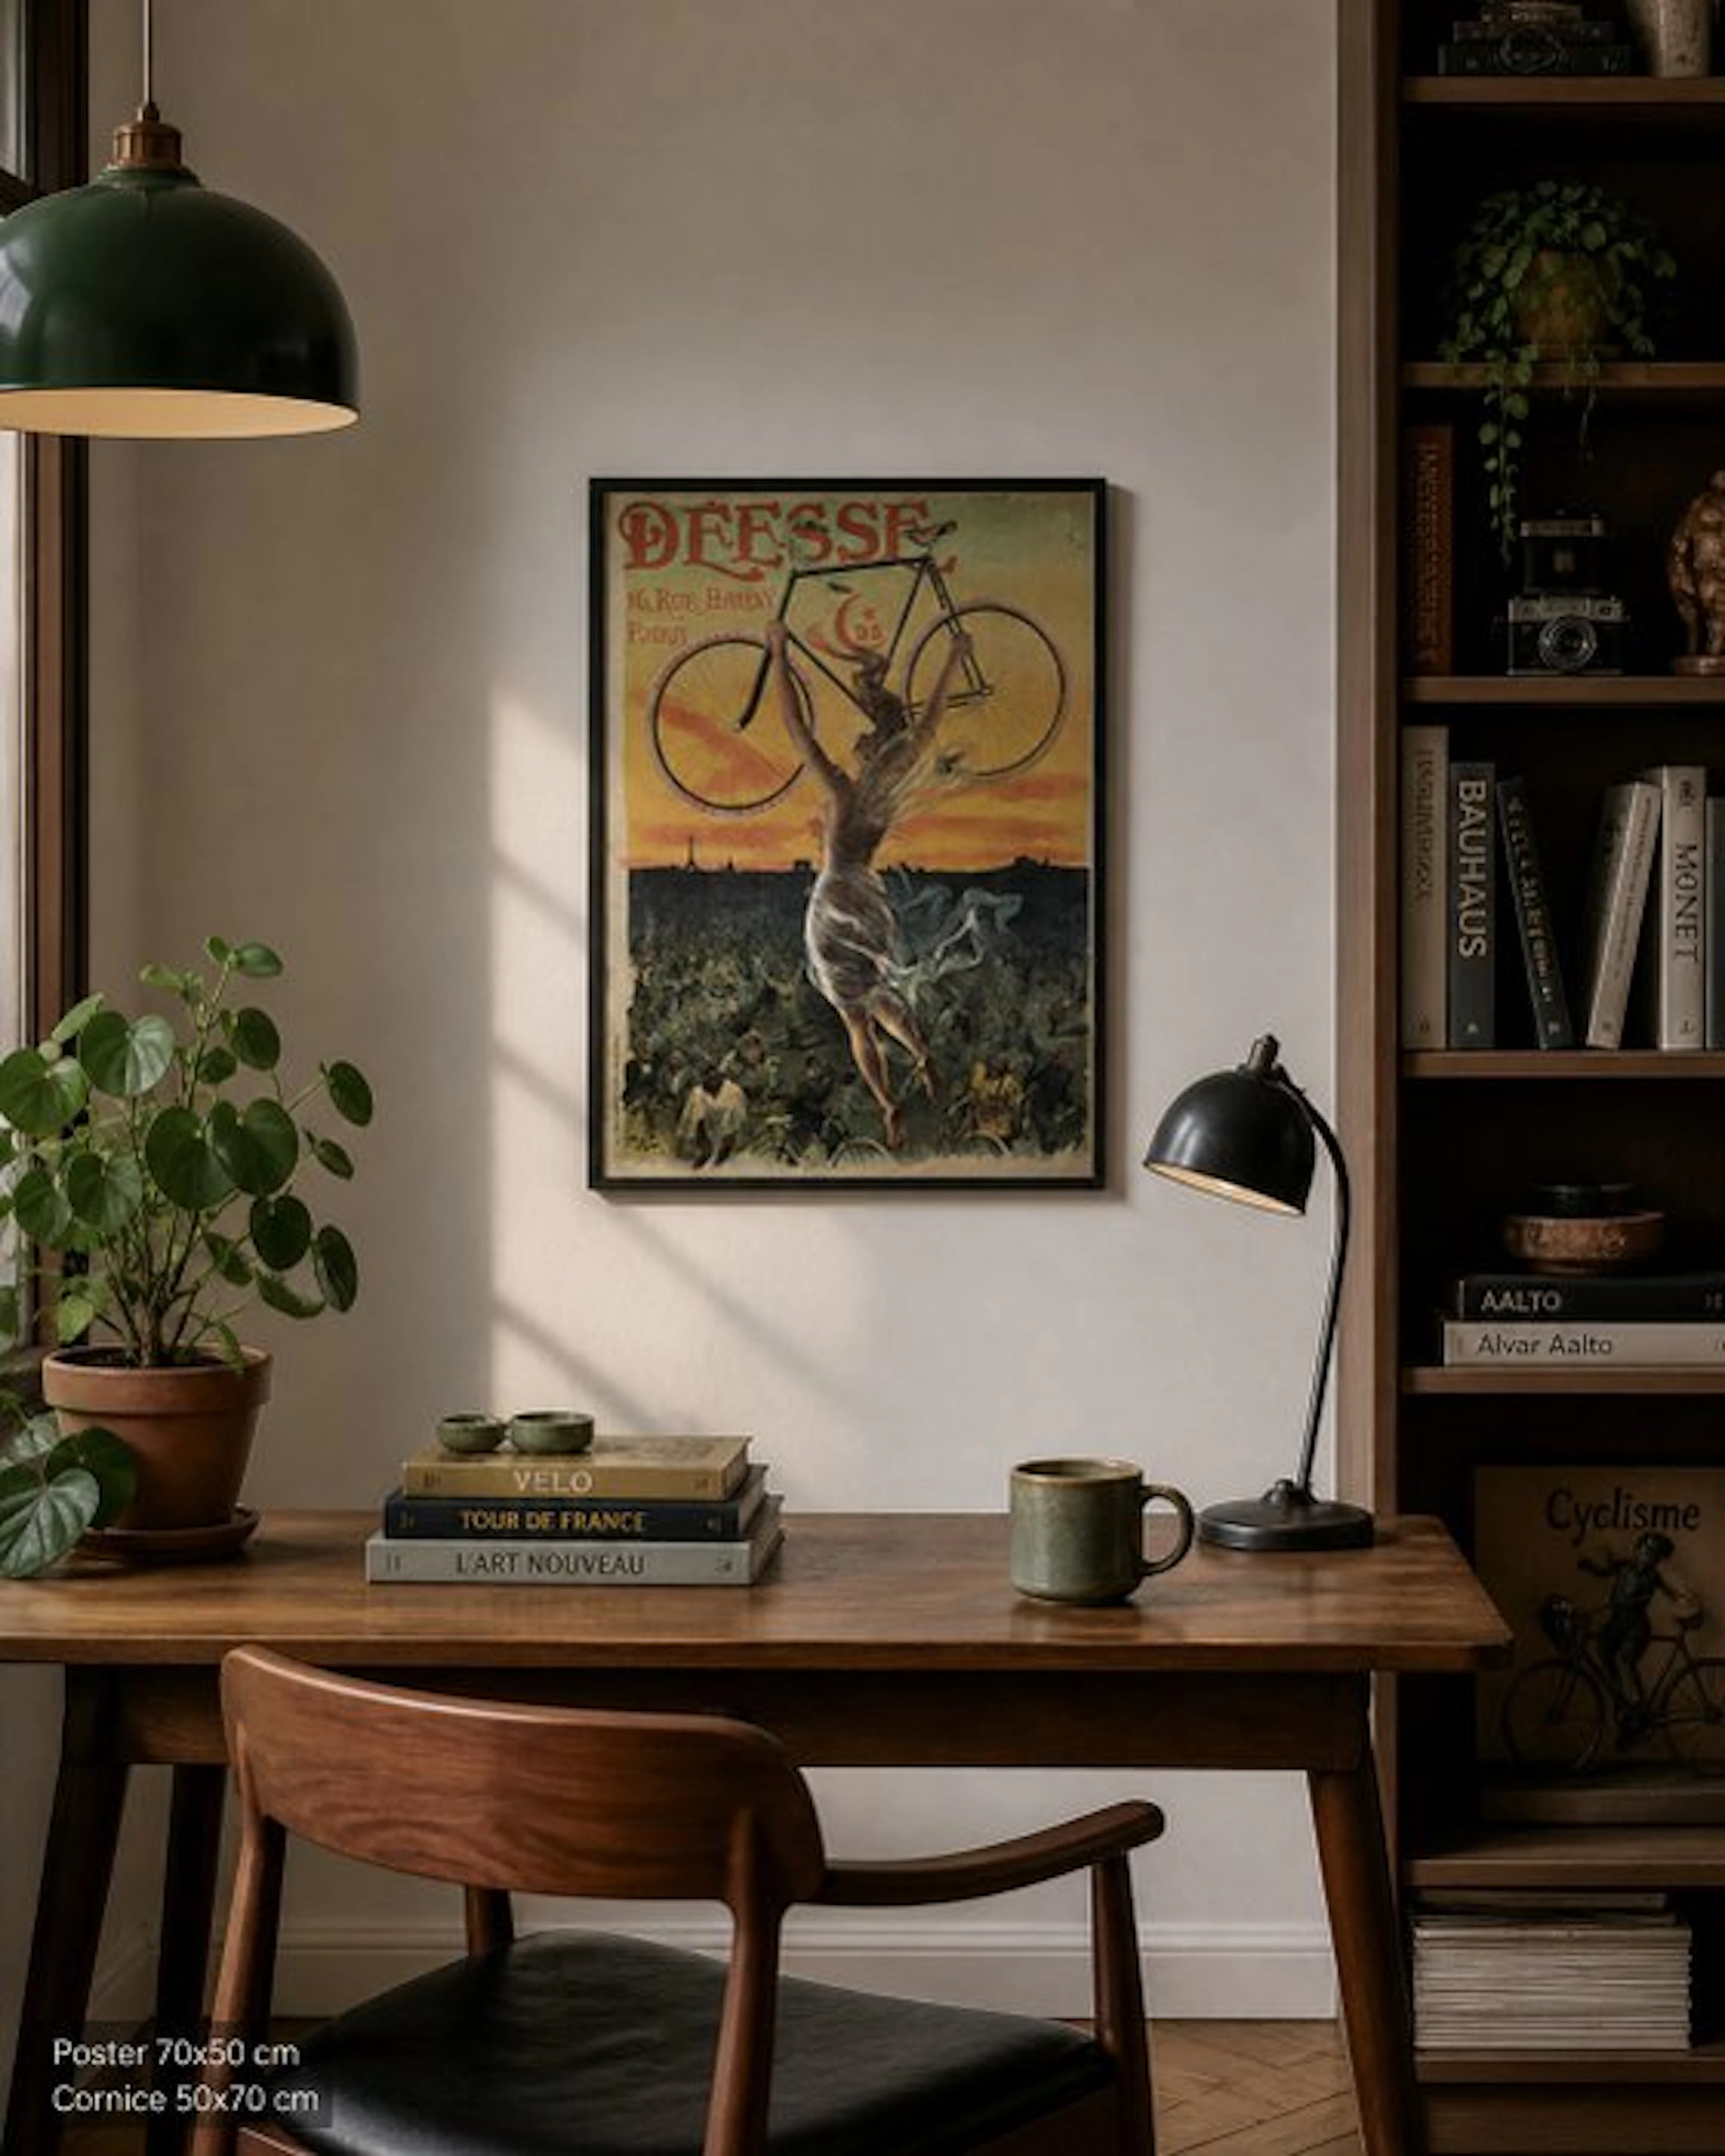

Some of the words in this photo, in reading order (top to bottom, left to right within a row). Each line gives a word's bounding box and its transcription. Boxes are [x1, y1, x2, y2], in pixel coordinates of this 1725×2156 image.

[1459, 781, 1486, 958] BAUHAUS
[1675, 843, 1698, 963] MONET
[1481, 1289, 1563, 1312] AALTO
[1476, 1333, 1541, 1356] Alvar
[1549, 1333, 1612, 1356] Aalto
[513, 1469, 593, 1493] VELO
[459, 1510, 519, 1530] TOUR
[525, 1511, 557, 1531] DE
[560, 1510, 646, 1532] FRANCE
[1547, 1487, 1701, 1547] Cyclisme
[456, 1552, 520, 1573] L'ART
[528, 1552, 644, 1574] NOUVEAU
